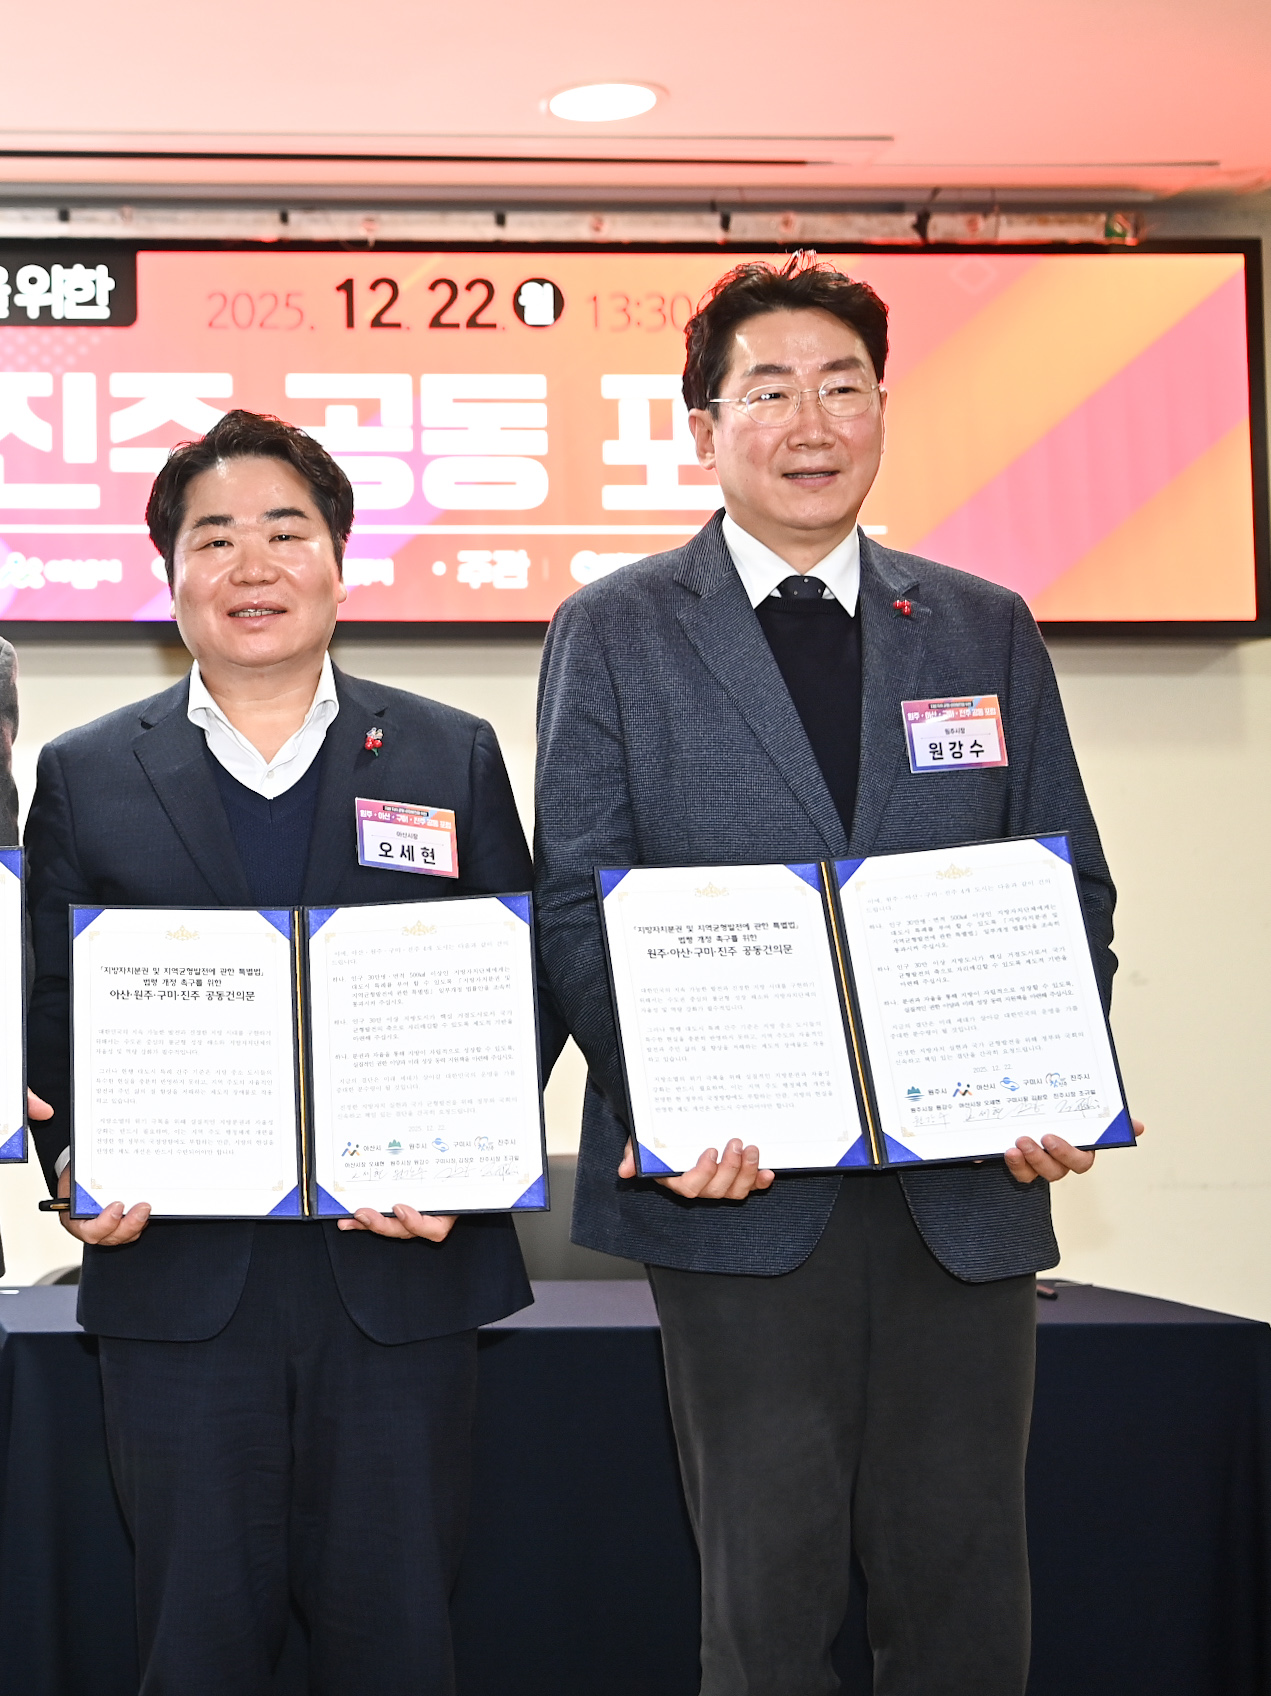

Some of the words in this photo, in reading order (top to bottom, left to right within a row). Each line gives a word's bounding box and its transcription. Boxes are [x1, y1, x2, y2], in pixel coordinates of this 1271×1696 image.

[14, 264, 114, 319] 위한
[208, 292, 316, 331] 2025.
[285, 373, 550, 510] 공동
[929, 740, 984, 760] 원강수
[378, 842, 436, 865] 오세현
[742, 933, 758, 943] 위한
[741, 943, 794, 957] 공동건의문
[206, 978, 222, 988] 위한
[204, 990, 256, 1002] 공동건의문
[928, 1088, 947, 1096] 원주시
[976, 1083, 996, 1091] 아산시
[1023, 1078, 1043, 1086] 구미시
[1070, 1073, 1090, 1082] 진주시
